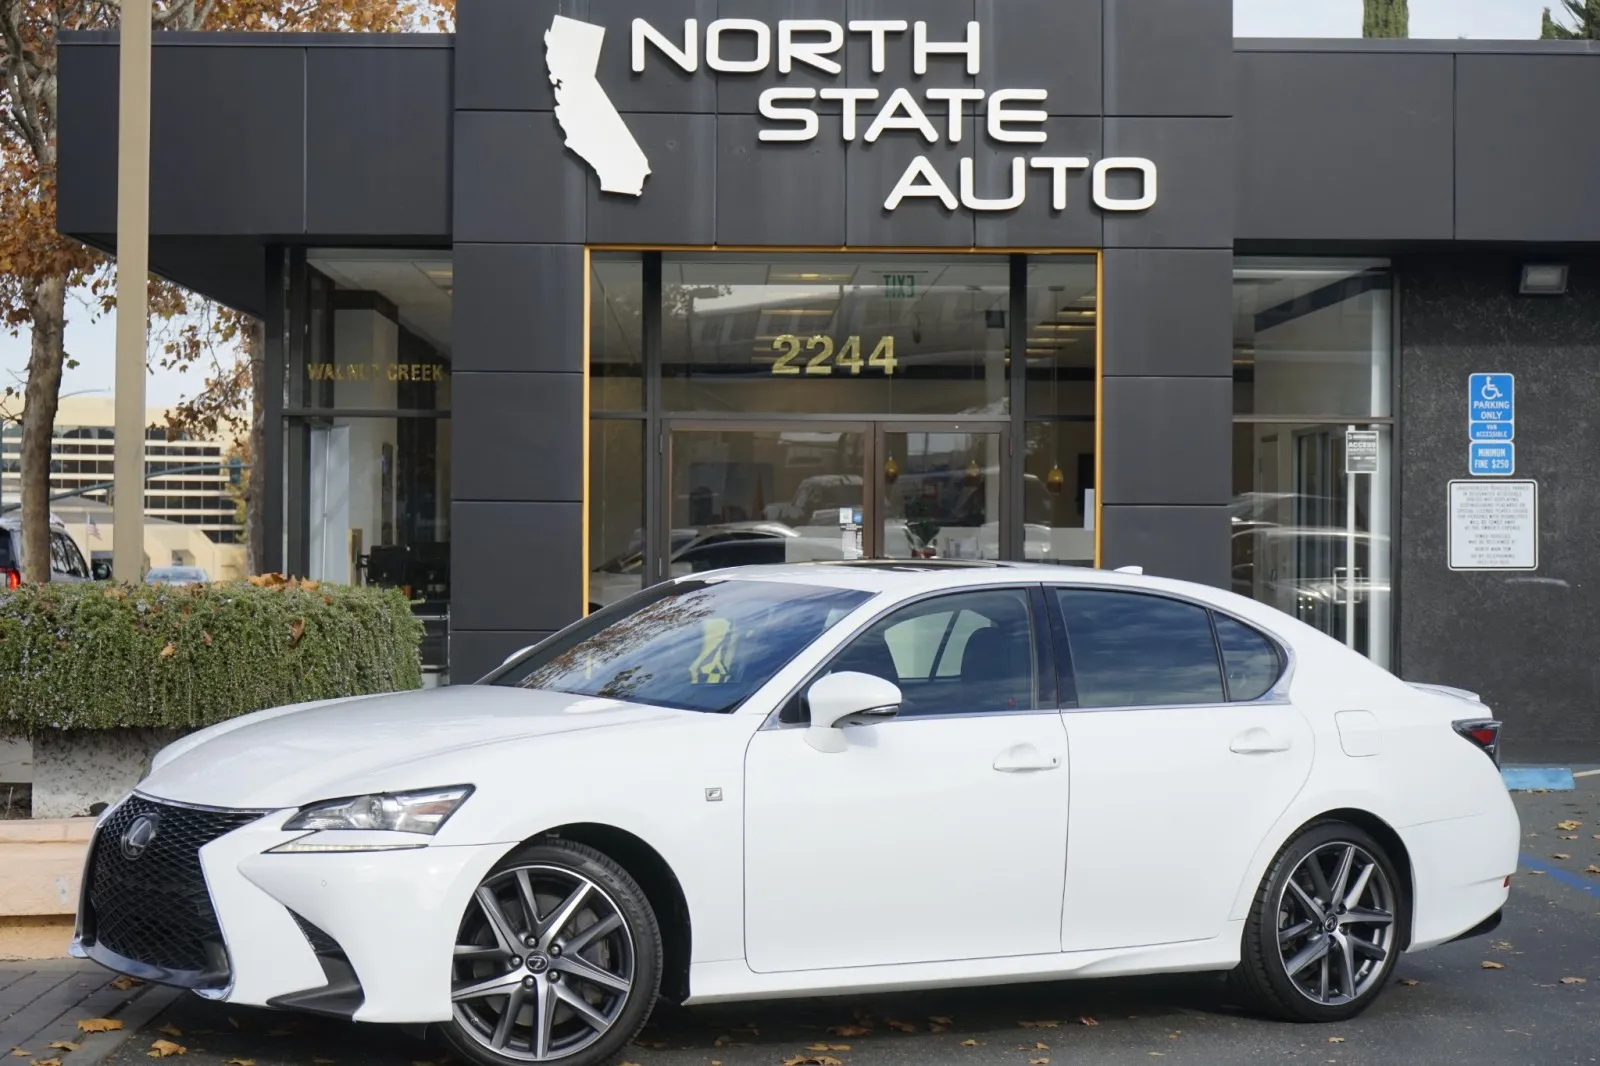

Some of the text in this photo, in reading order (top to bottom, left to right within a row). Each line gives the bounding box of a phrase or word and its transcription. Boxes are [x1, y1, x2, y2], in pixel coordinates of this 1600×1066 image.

[631, 18, 980, 75] NORTH
[758, 87, 1048, 143] STATE
[884, 155, 1157, 211] AUTO
[771, 334, 898, 375] 2244
[307, 363, 443, 381] WALNUT CREEK
[1473, 400, 1510, 410] PARKING
[1480, 411, 1503, 420] ONLY
[1478, 448, 1506, 457] MINIMUM
[1474, 459, 1509, 469] FINE $250
